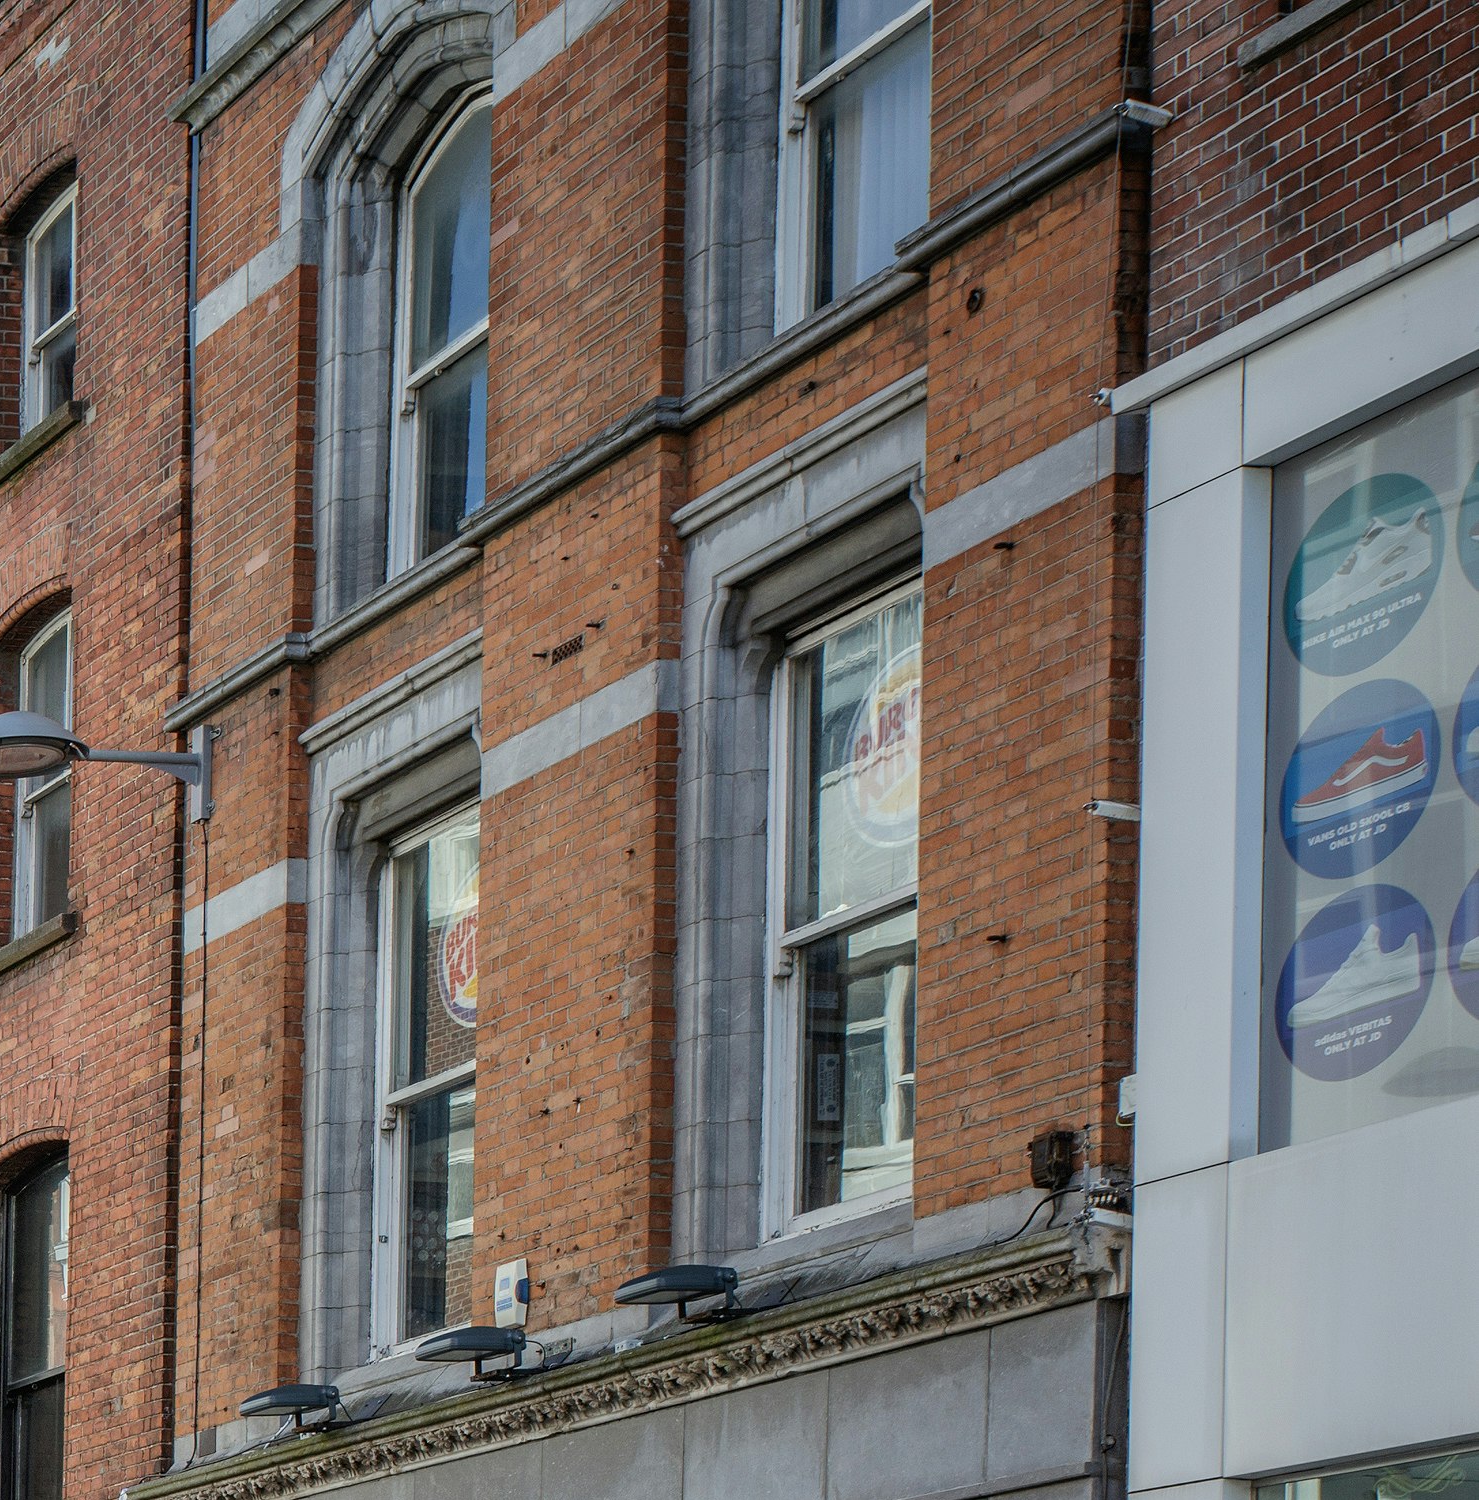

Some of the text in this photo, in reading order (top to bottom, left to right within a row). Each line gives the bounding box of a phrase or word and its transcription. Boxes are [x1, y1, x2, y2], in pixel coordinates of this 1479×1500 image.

[1303, 592, 1422, 650] NIKE AIR MAX 90 ULTRA
[1332, 618, 1390, 649] ONLY AT JD
[1308, 829, 1335, 847] VANS
[1337, 822, 1357, 836] OLD
[1359, 810, 1394, 829] SKOOL
[1329, 823, 1387, 851] ONLY AT JD
[1314, 1015, 1392, 1047] adidas VERITAS
[1324, 1031, 1382, 1056] ONLY AT JD
